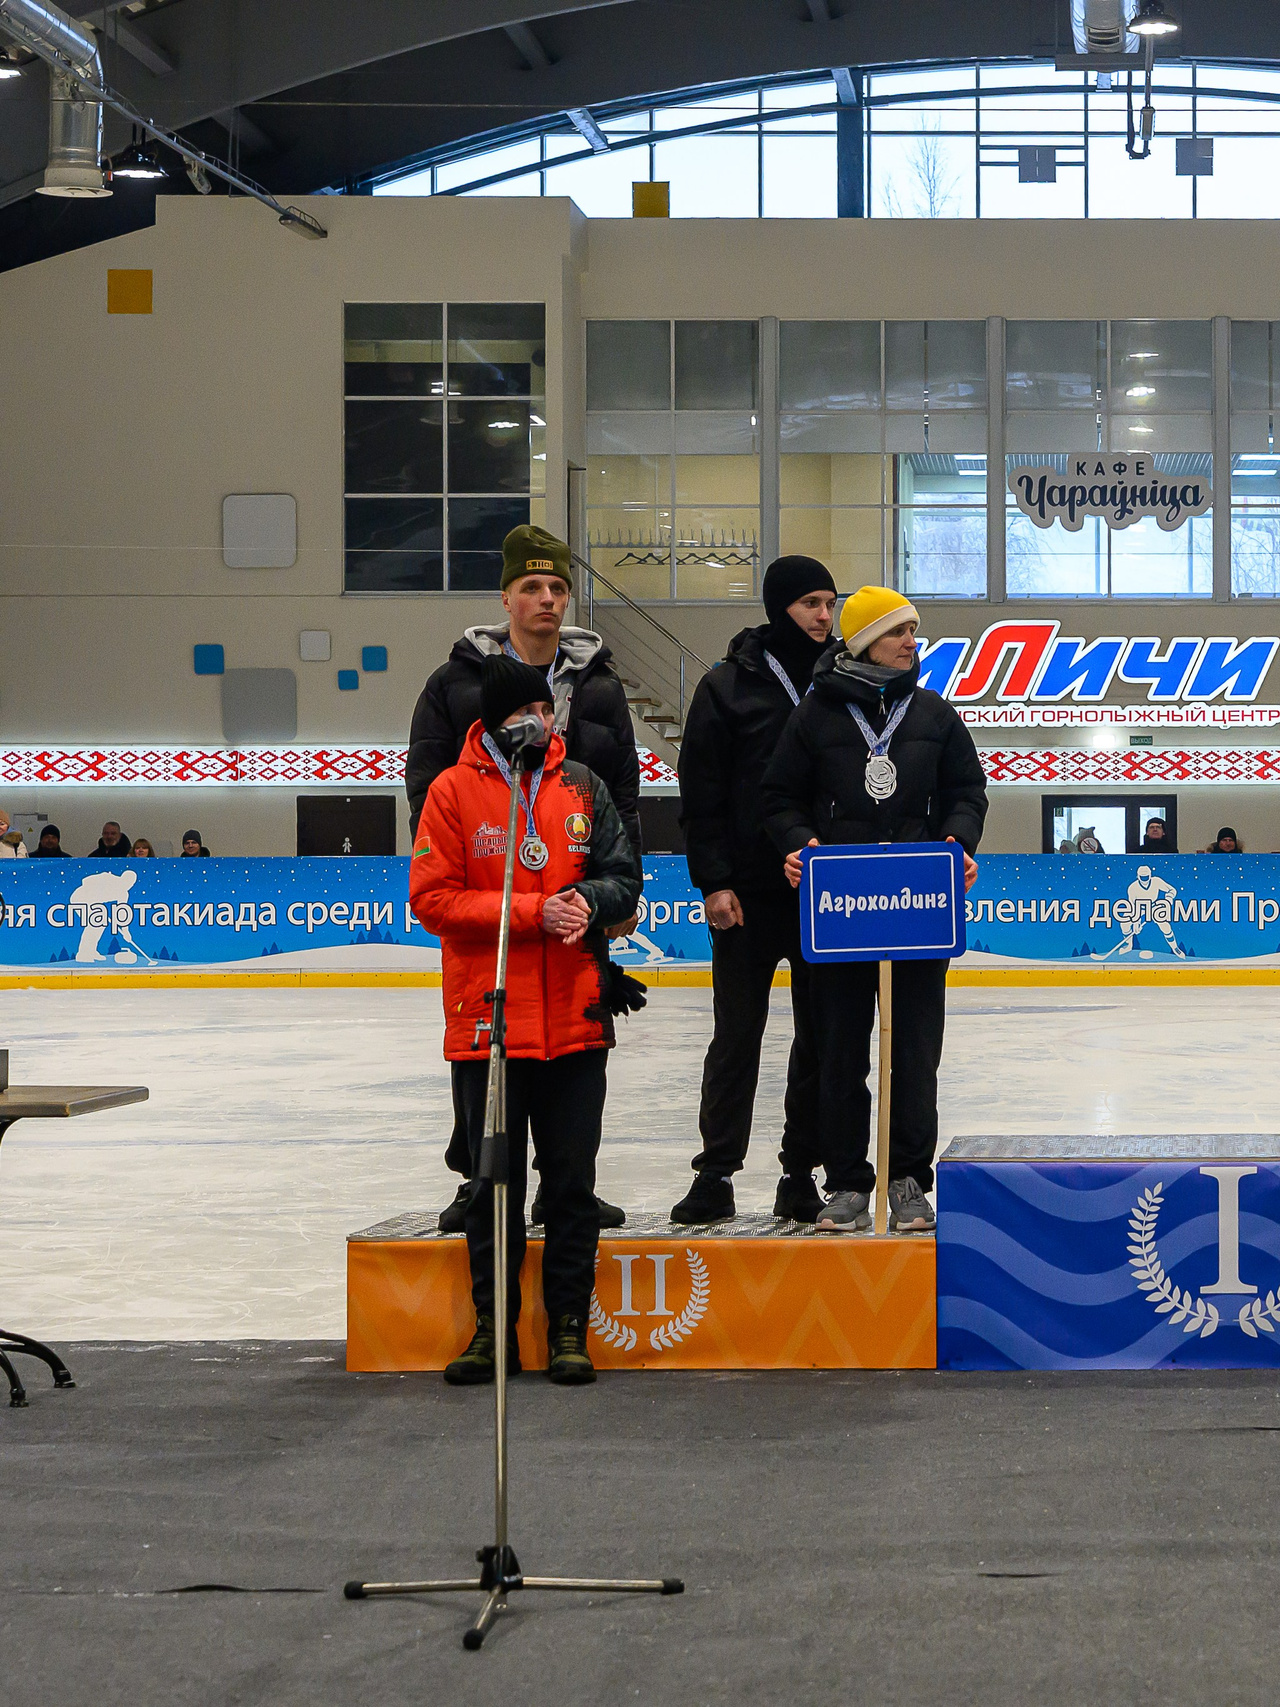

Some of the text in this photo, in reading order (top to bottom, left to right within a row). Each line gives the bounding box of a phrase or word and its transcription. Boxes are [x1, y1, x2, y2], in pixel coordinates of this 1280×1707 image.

[1076, 461, 1145, 476] КАФЕ
[1017, 474, 1205, 523] Чараўніца
[917, 621, 1279, 699] ИЛИЧИ
[1030, 706, 1211, 723] ГОРНОЛЫЖНЫЙ
[46, 900, 277, 933] спартакиада
[287, 900, 394, 933] среди
[1089, 899, 1221, 928] делами
[818, 886, 948, 918] Агрохолдинг
[1199, 1166, 1258, 1294] I
[612, 1253, 675, 1316] II
